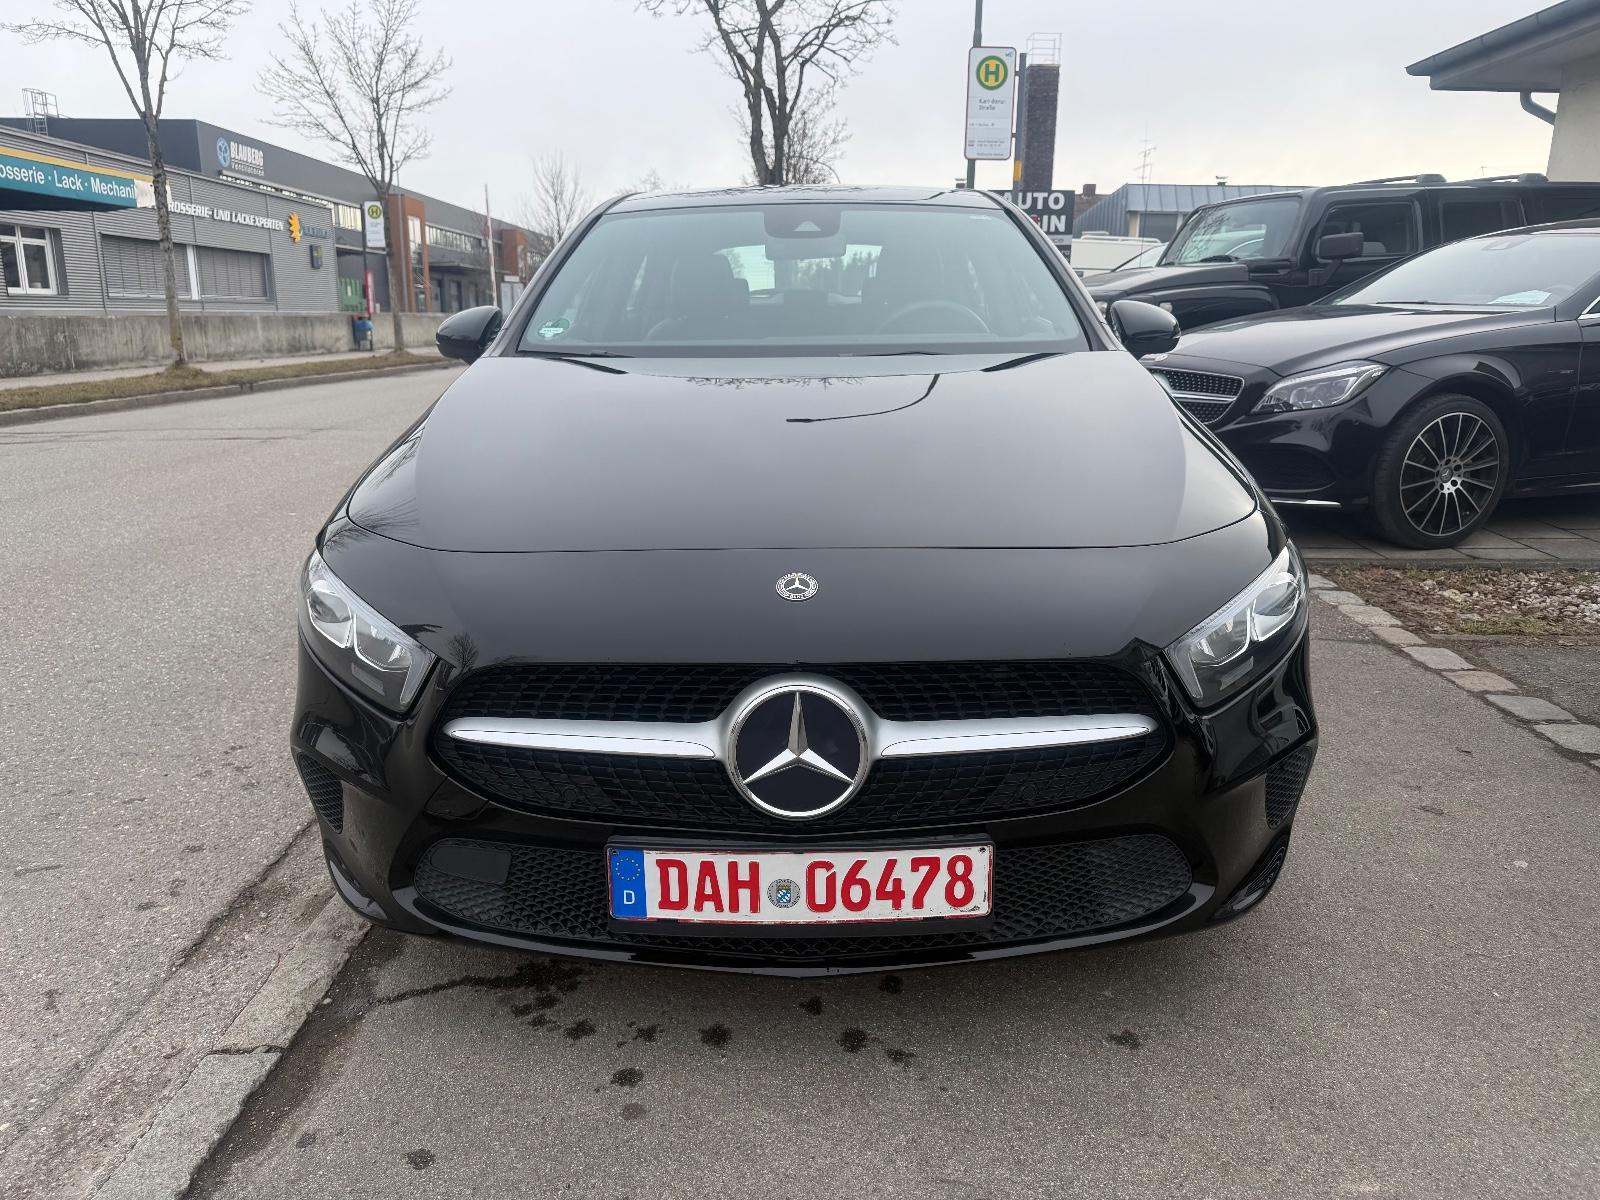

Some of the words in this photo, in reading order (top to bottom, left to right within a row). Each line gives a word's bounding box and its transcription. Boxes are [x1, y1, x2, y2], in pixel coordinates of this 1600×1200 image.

[984, 63, 1000, 83] H
[53, 170, 84, 191] Lack
[213, 207, 231, 222] UND
[232, 211, 284, 231] LACKEXPERTEN
[655, 858, 761, 914] DAH
[805, 854, 975, 913] 06478
[623, 889, 636, 905] D
